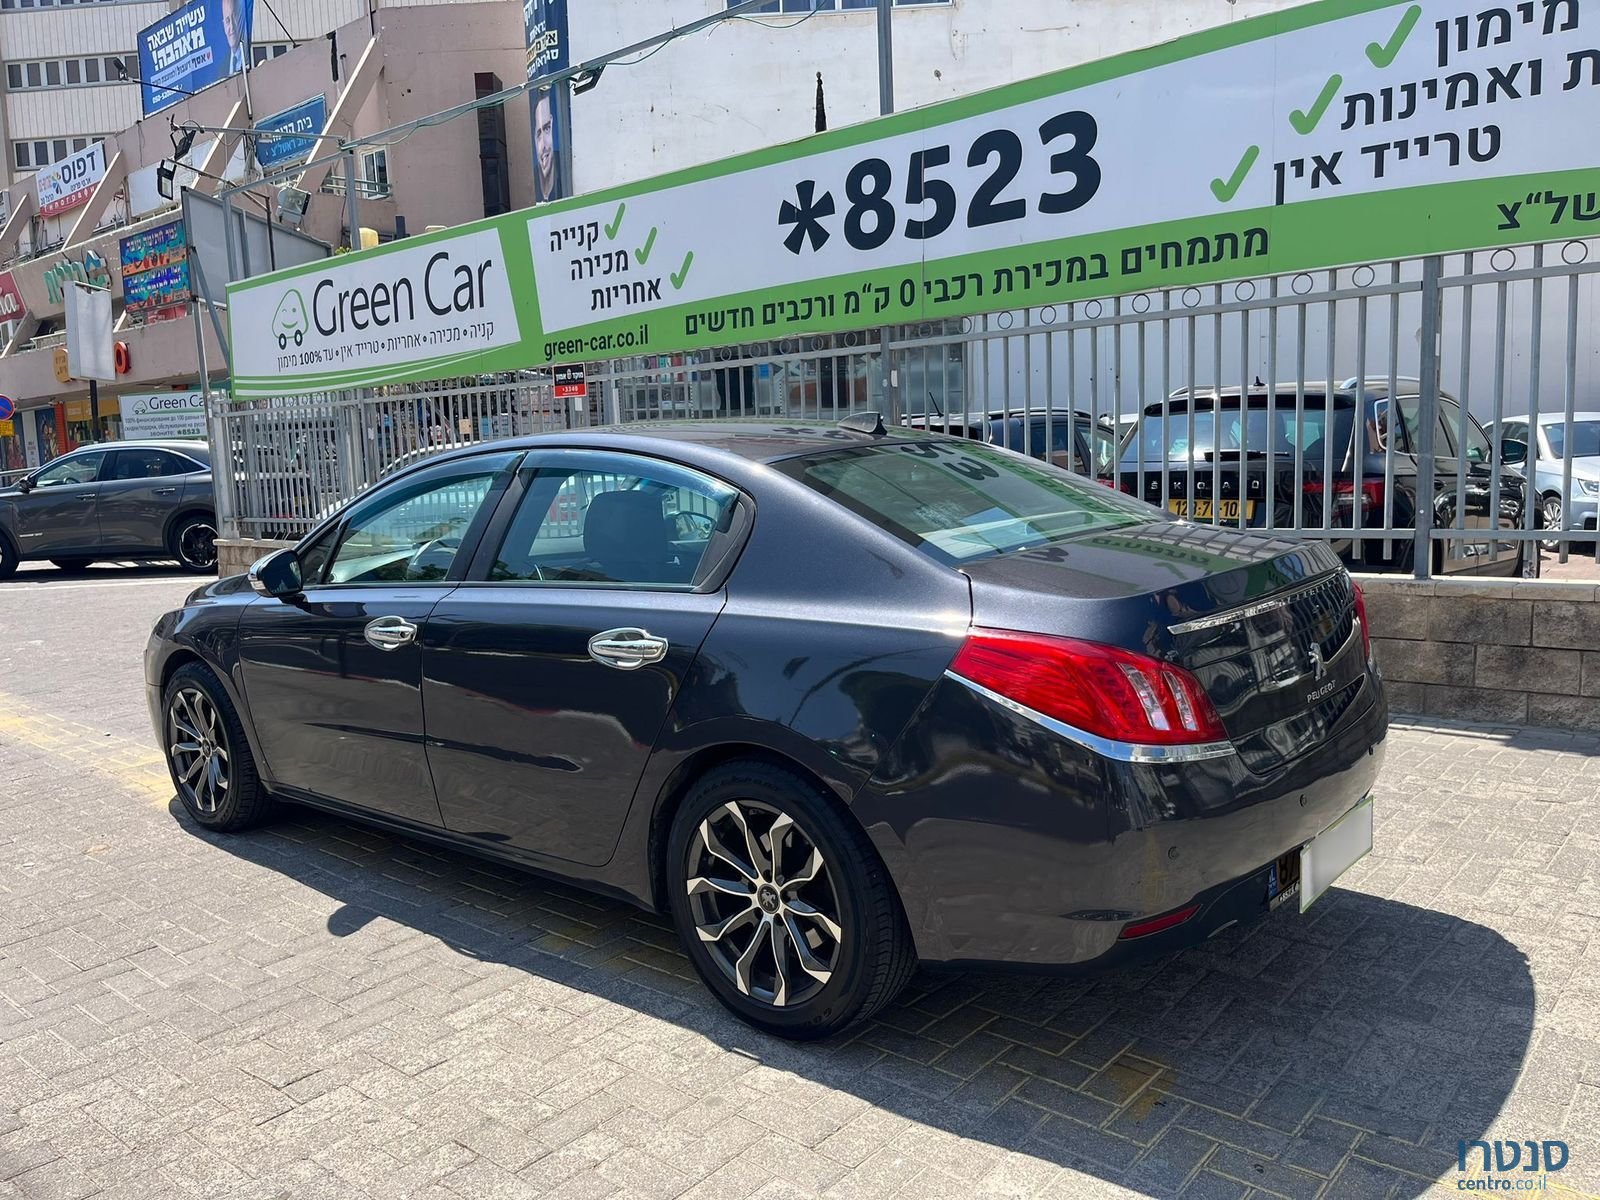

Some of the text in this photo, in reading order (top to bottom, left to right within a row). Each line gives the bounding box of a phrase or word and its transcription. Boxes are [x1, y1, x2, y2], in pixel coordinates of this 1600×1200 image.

[147, 5, 206, 51] עשייה שבאה
[1435, 0, 1580, 68] מימון
[152, 26, 206, 72] מאהבה!
[1340, 58, 1542, 130] ואמינות
[297, 116, 313, 132] בית
[61, 151, 96, 184] דפוס
[1274, 124, 1502, 205] טרייד אין
[550, 221, 598, 252] קנייה
[1121, 228, 1269, 273] מתמחים
[571, 249, 629, 281] מכירה
[992, 253, 1109, 295] במכירת
[313, 251, 492, 337] Green Car
[590, 278, 662, 311] אחריות
[900, 278, 915, 308] 0
[923, 272, 983, 302] רכבי
[685, 306, 754, 336] חדשים
[762, 293, 835, 326] ורכבים
[277, 320, 494, 372] קניה מכירה אחריות טרייד אין עד 100% מימון
[544, 324, 649, 361] green-car.co.il
[149, 394, 205, 410] Green Ca
[1306, 680, 1336, 703] PEUGEOT
